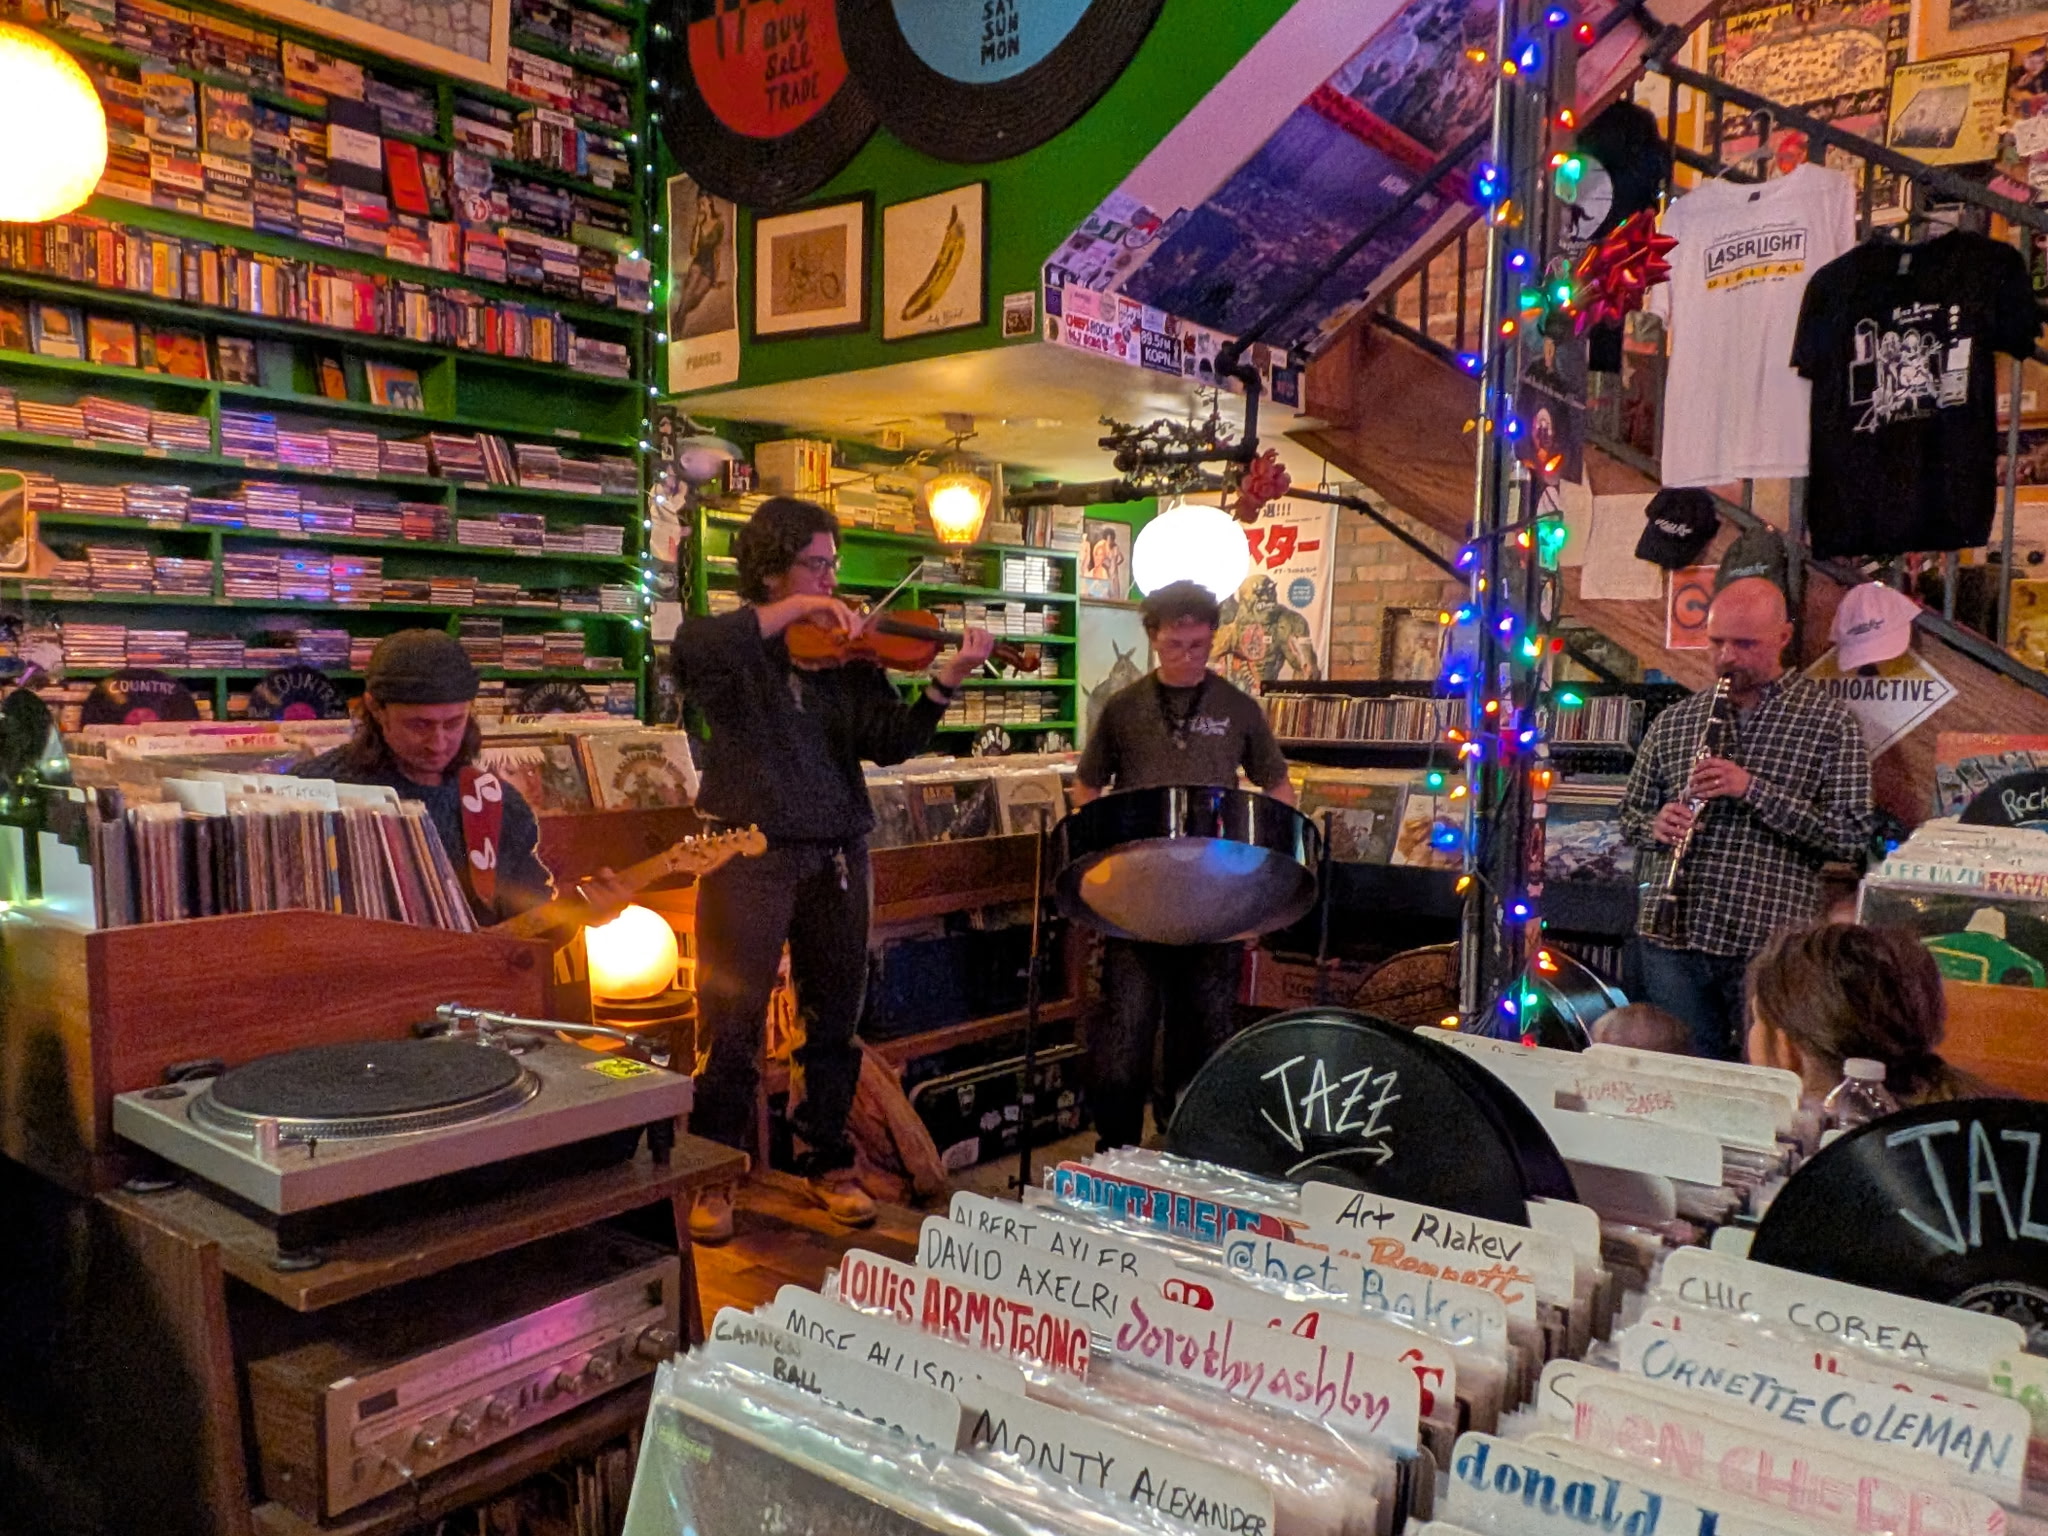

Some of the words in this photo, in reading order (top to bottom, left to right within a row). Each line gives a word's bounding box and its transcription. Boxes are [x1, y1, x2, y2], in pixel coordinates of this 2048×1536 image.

[982, 13, 1019, 41] SUN
[980, 35, 1020, 66] MON
[765, 72, 820, 114] TRADE
[1145, 347, 1171, 366] KOPN
[109, 680, 177, 696] COUNTRY
[1261, 1055, 1401, 1152] JAZZ
[1336, 1193, 1396, 1230] Art
[926, 1228, 1002, 1281] DAVID
[921, 1277, 1090, 1383] ARMSTRONG
[1787, 1302, 1928, 1358] COREA
[772, 1356, 822, 1394] BALL
[1642, 1338, 1816, 1425] ORNETTE
[971, 1408, 1115, 1489] MONTY
[1129, 1466, 1267, 1536] ALEXANDER
